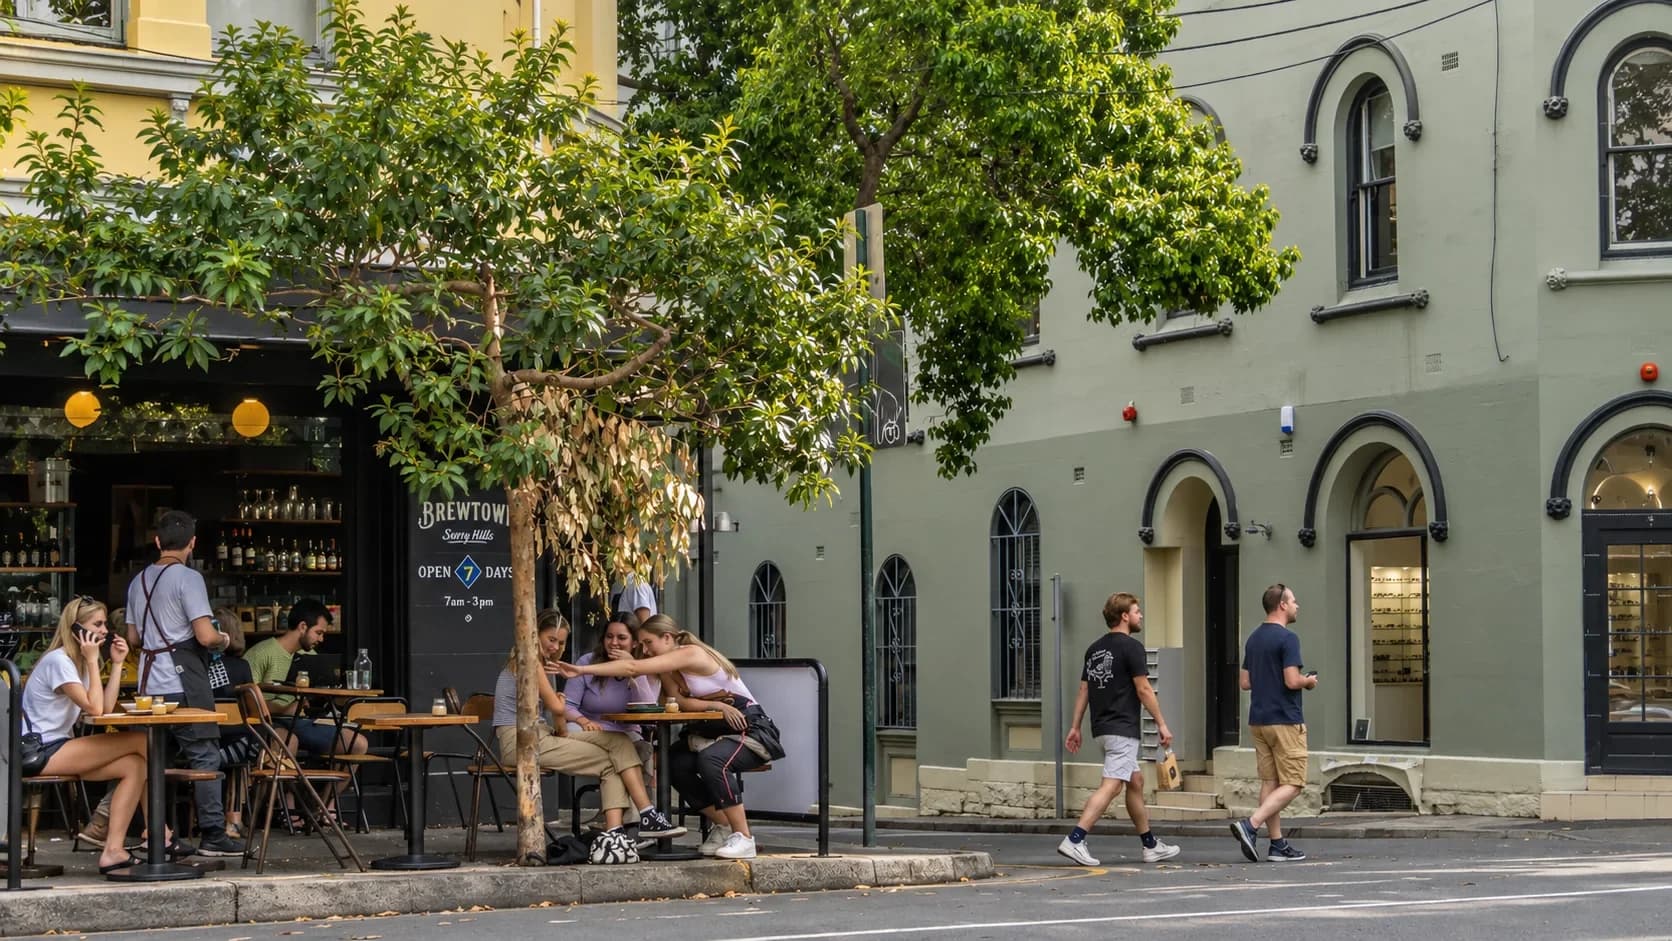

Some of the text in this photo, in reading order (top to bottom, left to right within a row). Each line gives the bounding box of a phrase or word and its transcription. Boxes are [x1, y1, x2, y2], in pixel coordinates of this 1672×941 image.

[472, 529, 494, 541] Hills
[418, 565, 451, 578] OPEN
[463, 566, 474, 581] 7
